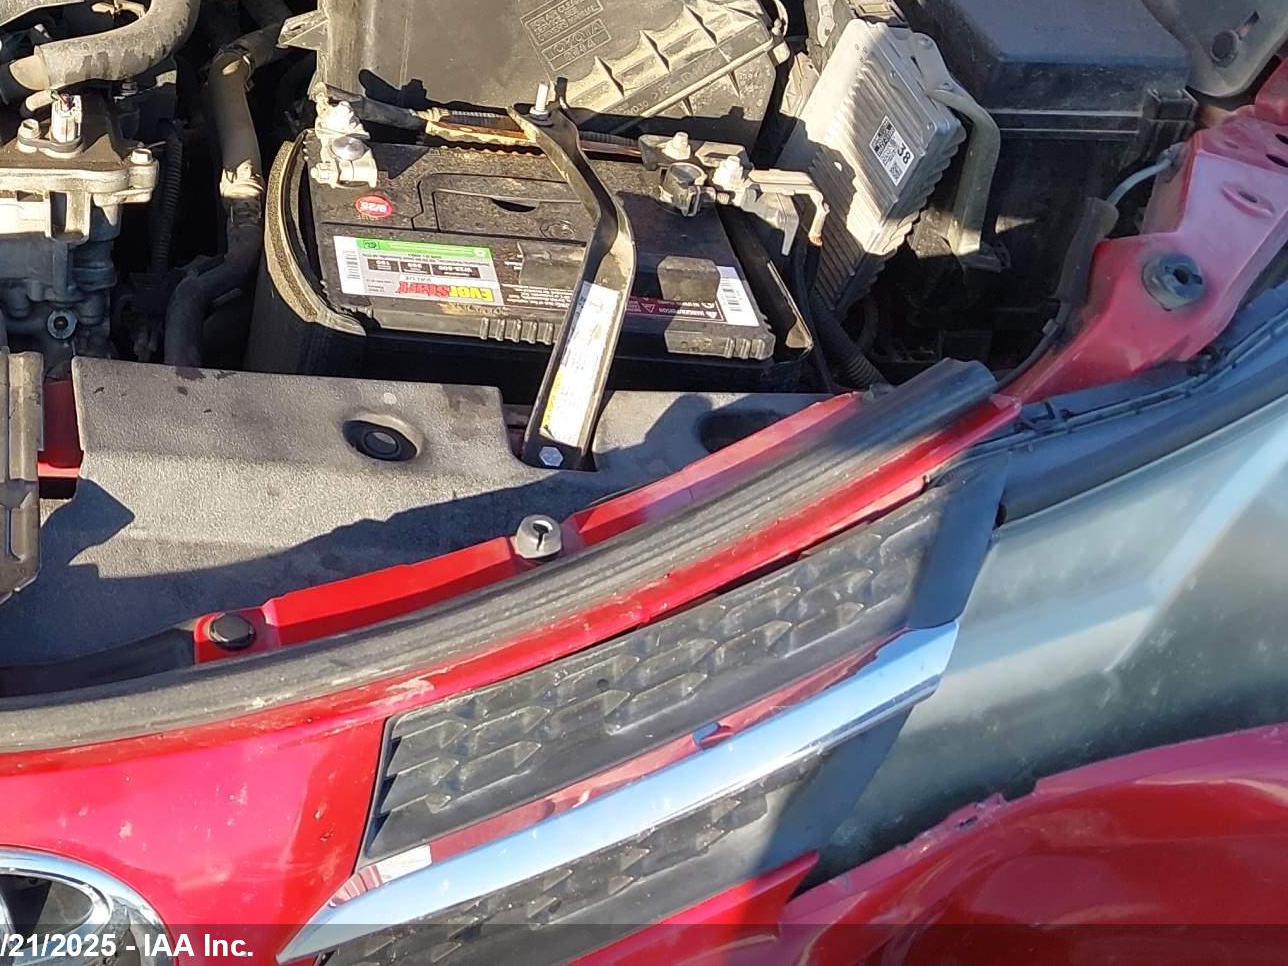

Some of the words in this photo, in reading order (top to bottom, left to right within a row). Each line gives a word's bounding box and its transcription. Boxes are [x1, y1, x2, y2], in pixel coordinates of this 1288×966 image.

[544, 19, 605, 58] TOYOTA
[898, 144, 911, 164] 38
[398, 281, 495, 303] EverStart
